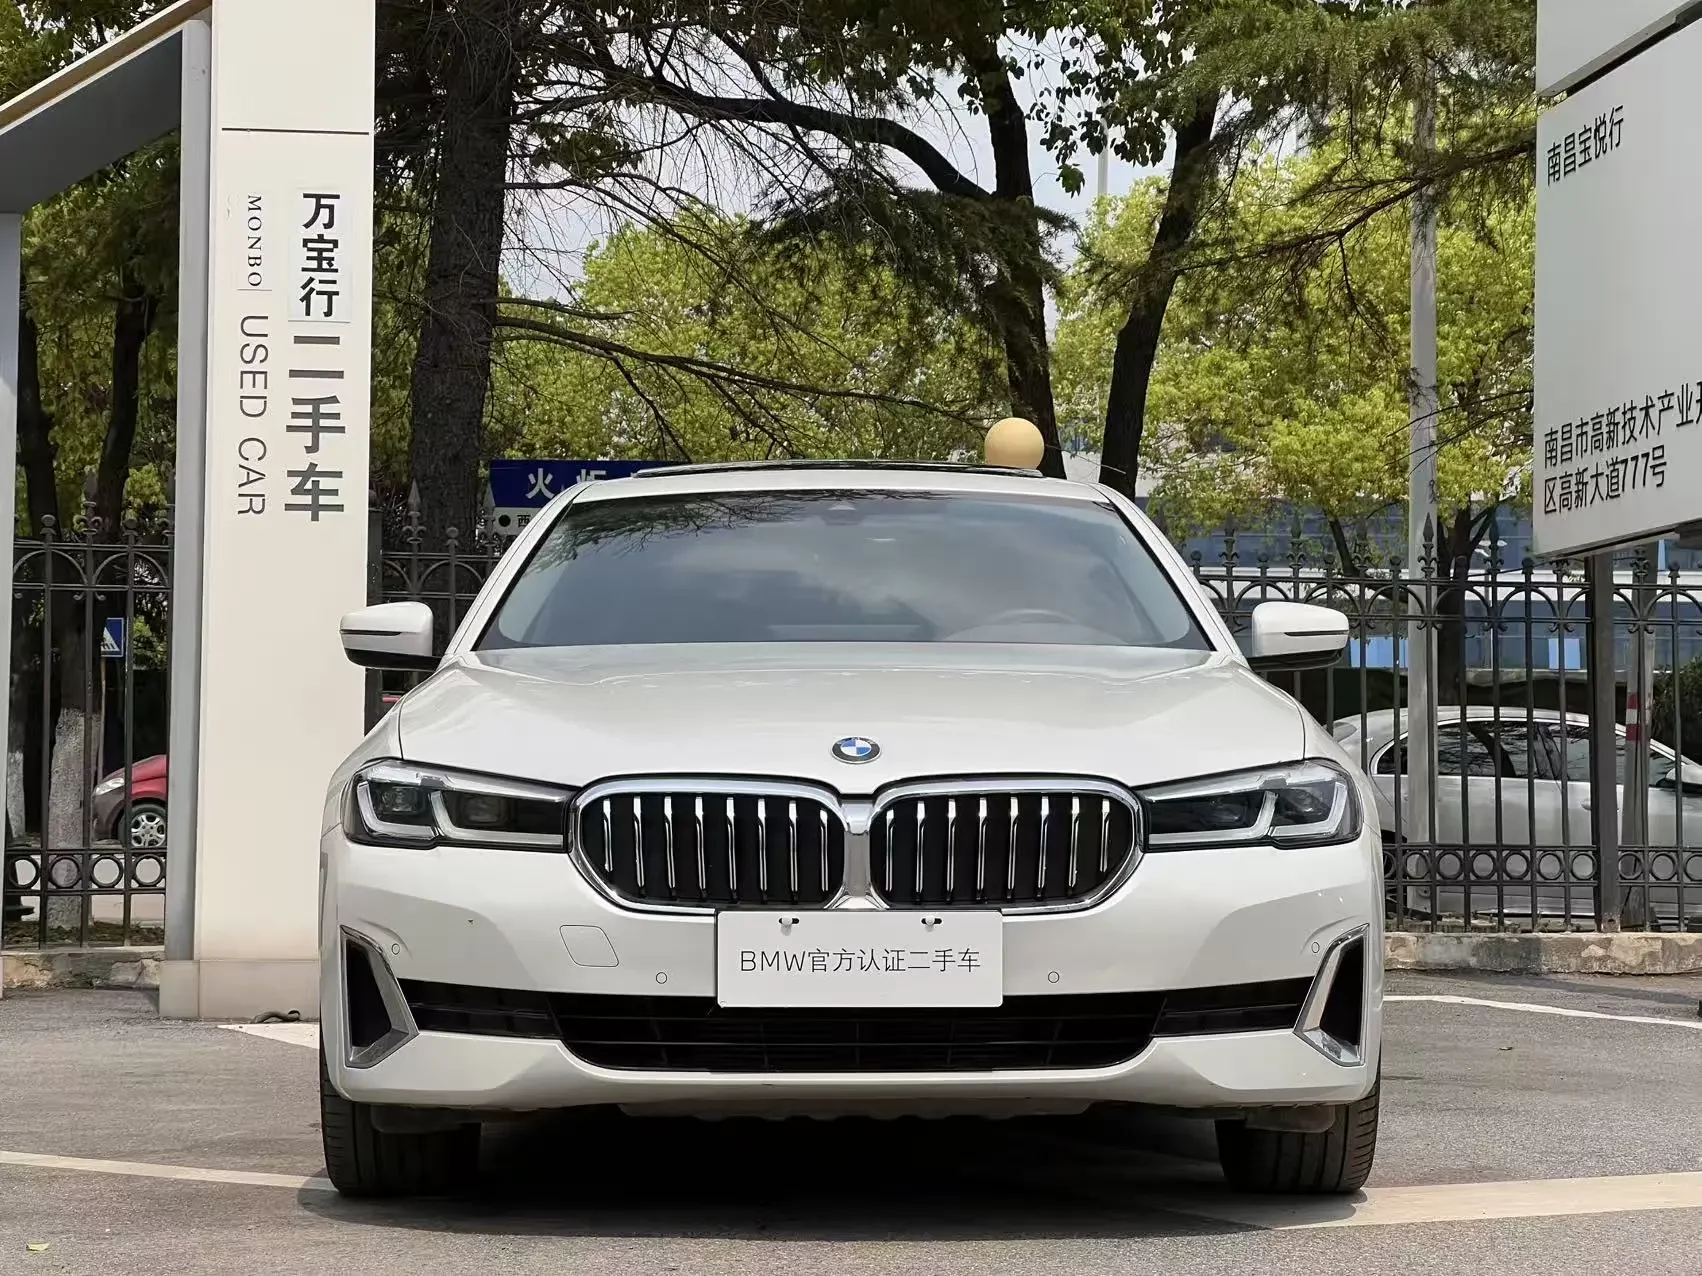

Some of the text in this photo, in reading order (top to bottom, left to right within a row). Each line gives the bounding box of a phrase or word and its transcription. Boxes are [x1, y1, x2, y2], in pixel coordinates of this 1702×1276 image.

[1547, 105, 1624, 186] 南昌宝悦行
[237, 195, 268, 515] MONBO USED CAR
[1544, 444, 1667, 515] 区高新大道777号
[740, 948, 981, 973] BMW官方认证二手车
